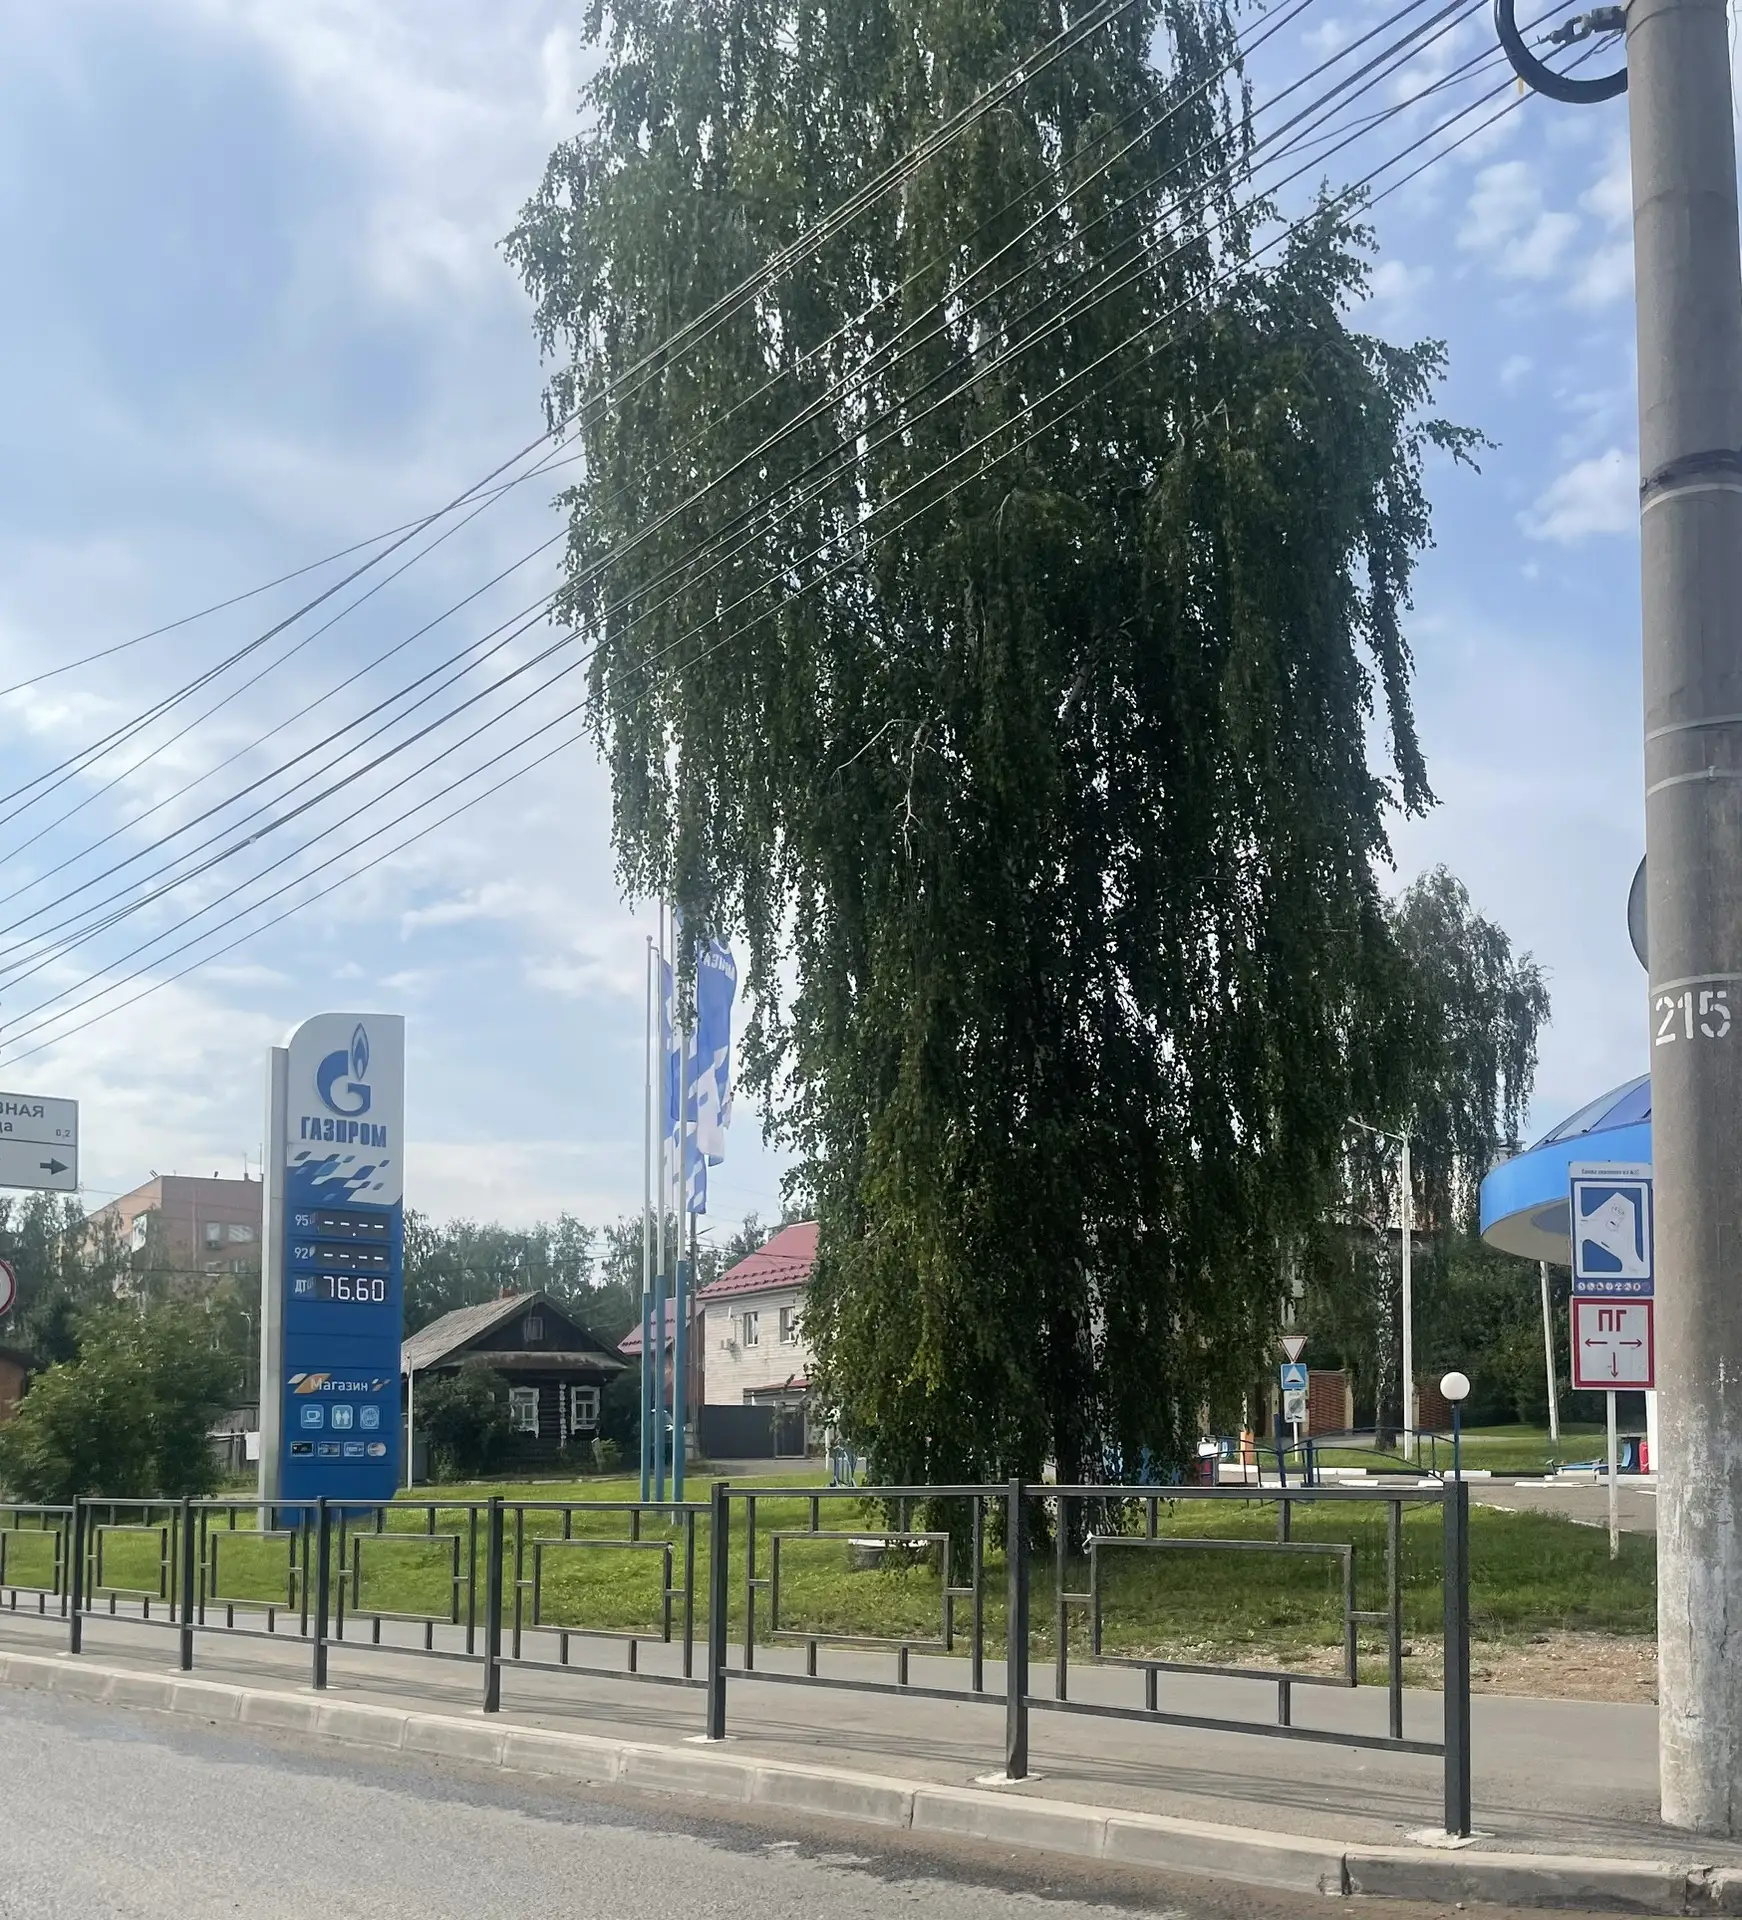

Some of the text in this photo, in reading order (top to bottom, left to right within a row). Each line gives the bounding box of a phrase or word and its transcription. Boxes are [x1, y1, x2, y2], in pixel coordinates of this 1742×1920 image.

[1655, 990, 1731, 1046] 215
[301, 1116, 387, 1148] ГАЗПРОМ
[295, 1214, 309, 1226] 95
[294, 1247, 309, 1259] 92
[323, 1275, 385, 1301] 76.60
[1598, 1309, 1627, 1332] ПГ
[310, 1378, 369, 1392] Магазин
